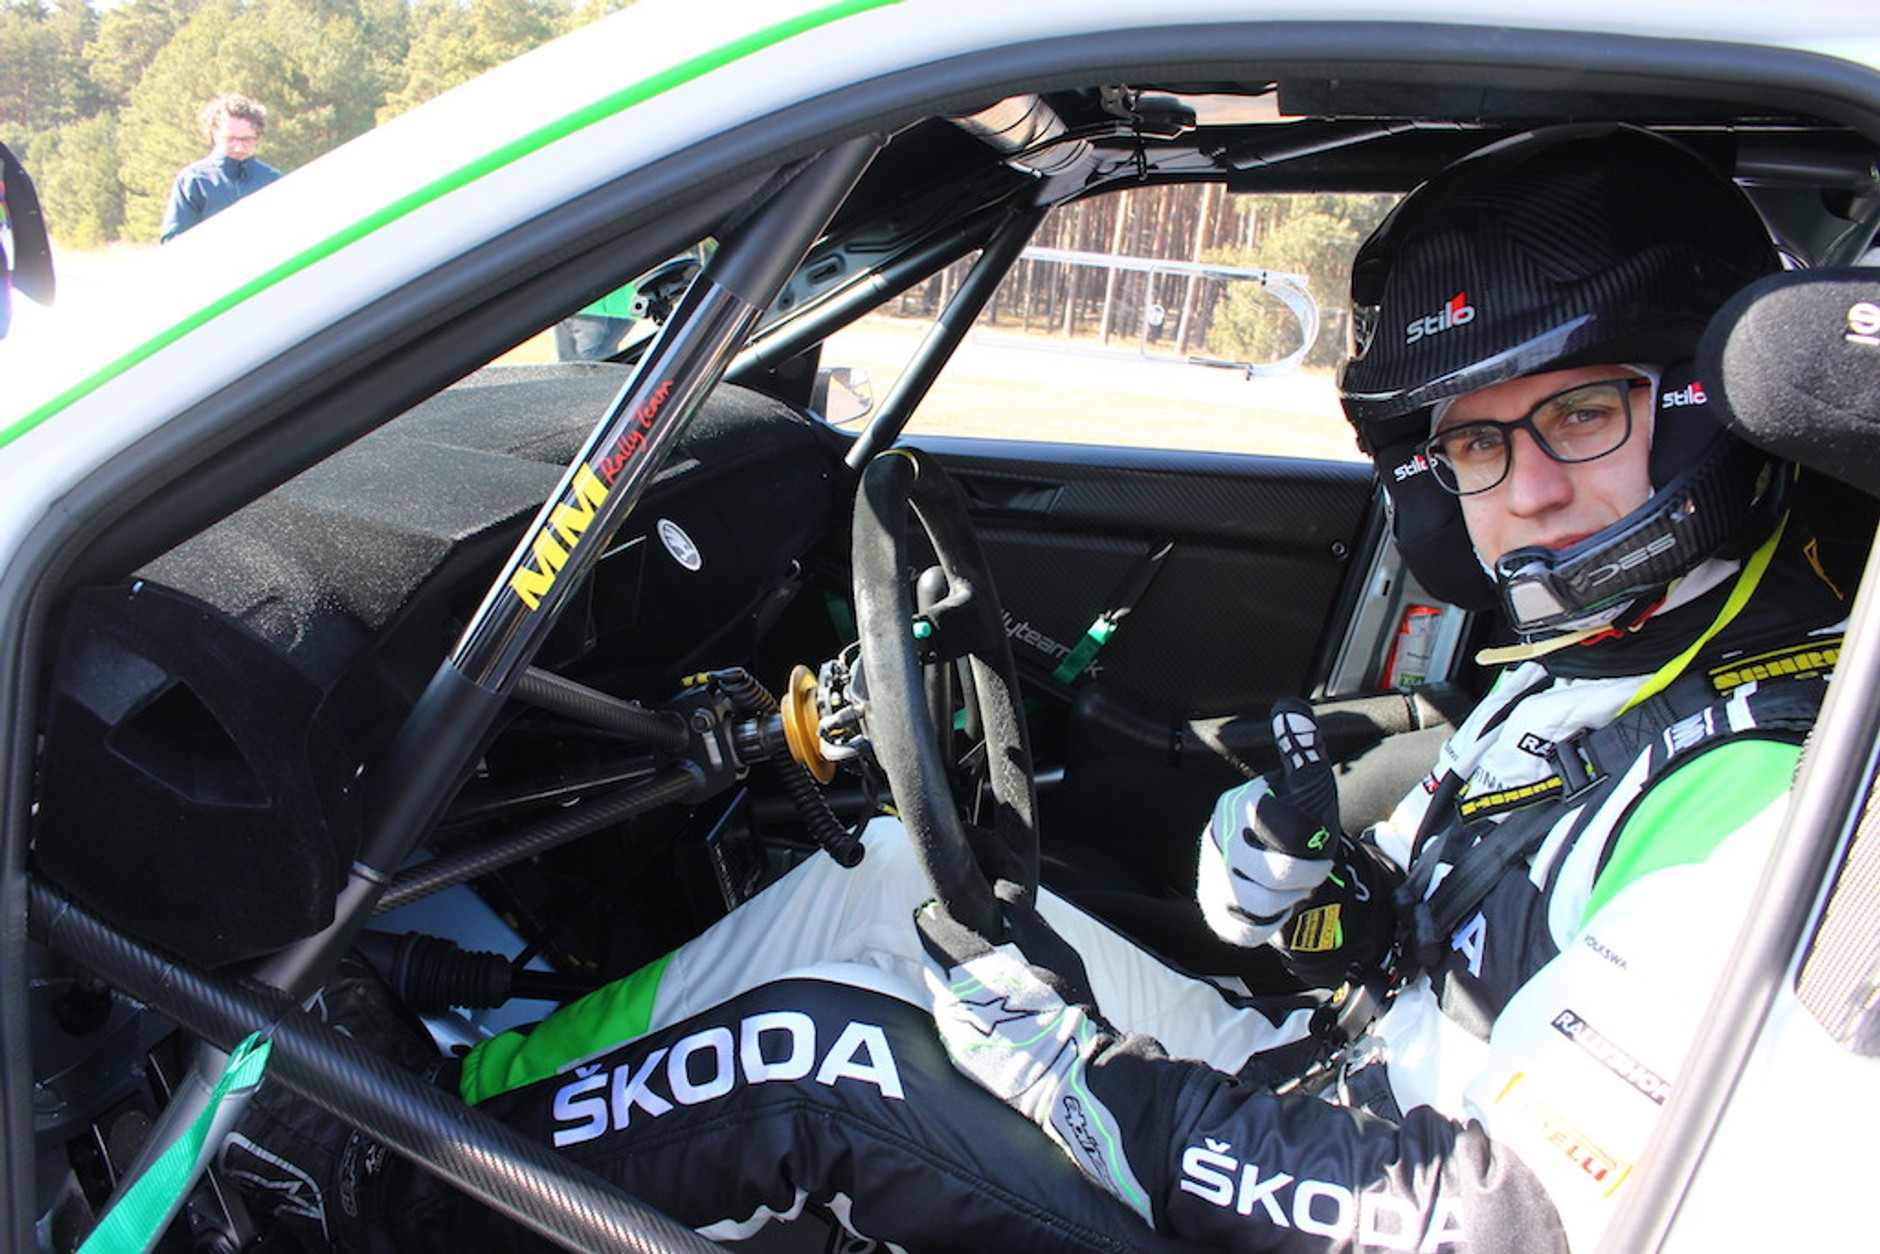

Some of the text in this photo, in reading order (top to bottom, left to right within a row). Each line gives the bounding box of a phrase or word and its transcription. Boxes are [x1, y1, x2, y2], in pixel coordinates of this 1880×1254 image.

[509, 379, 674, 611] MM Rally Team
[551, 1010, 906, 1148] ŠKODA
[1180, 1138, 1471, 1253] ŠKODA
